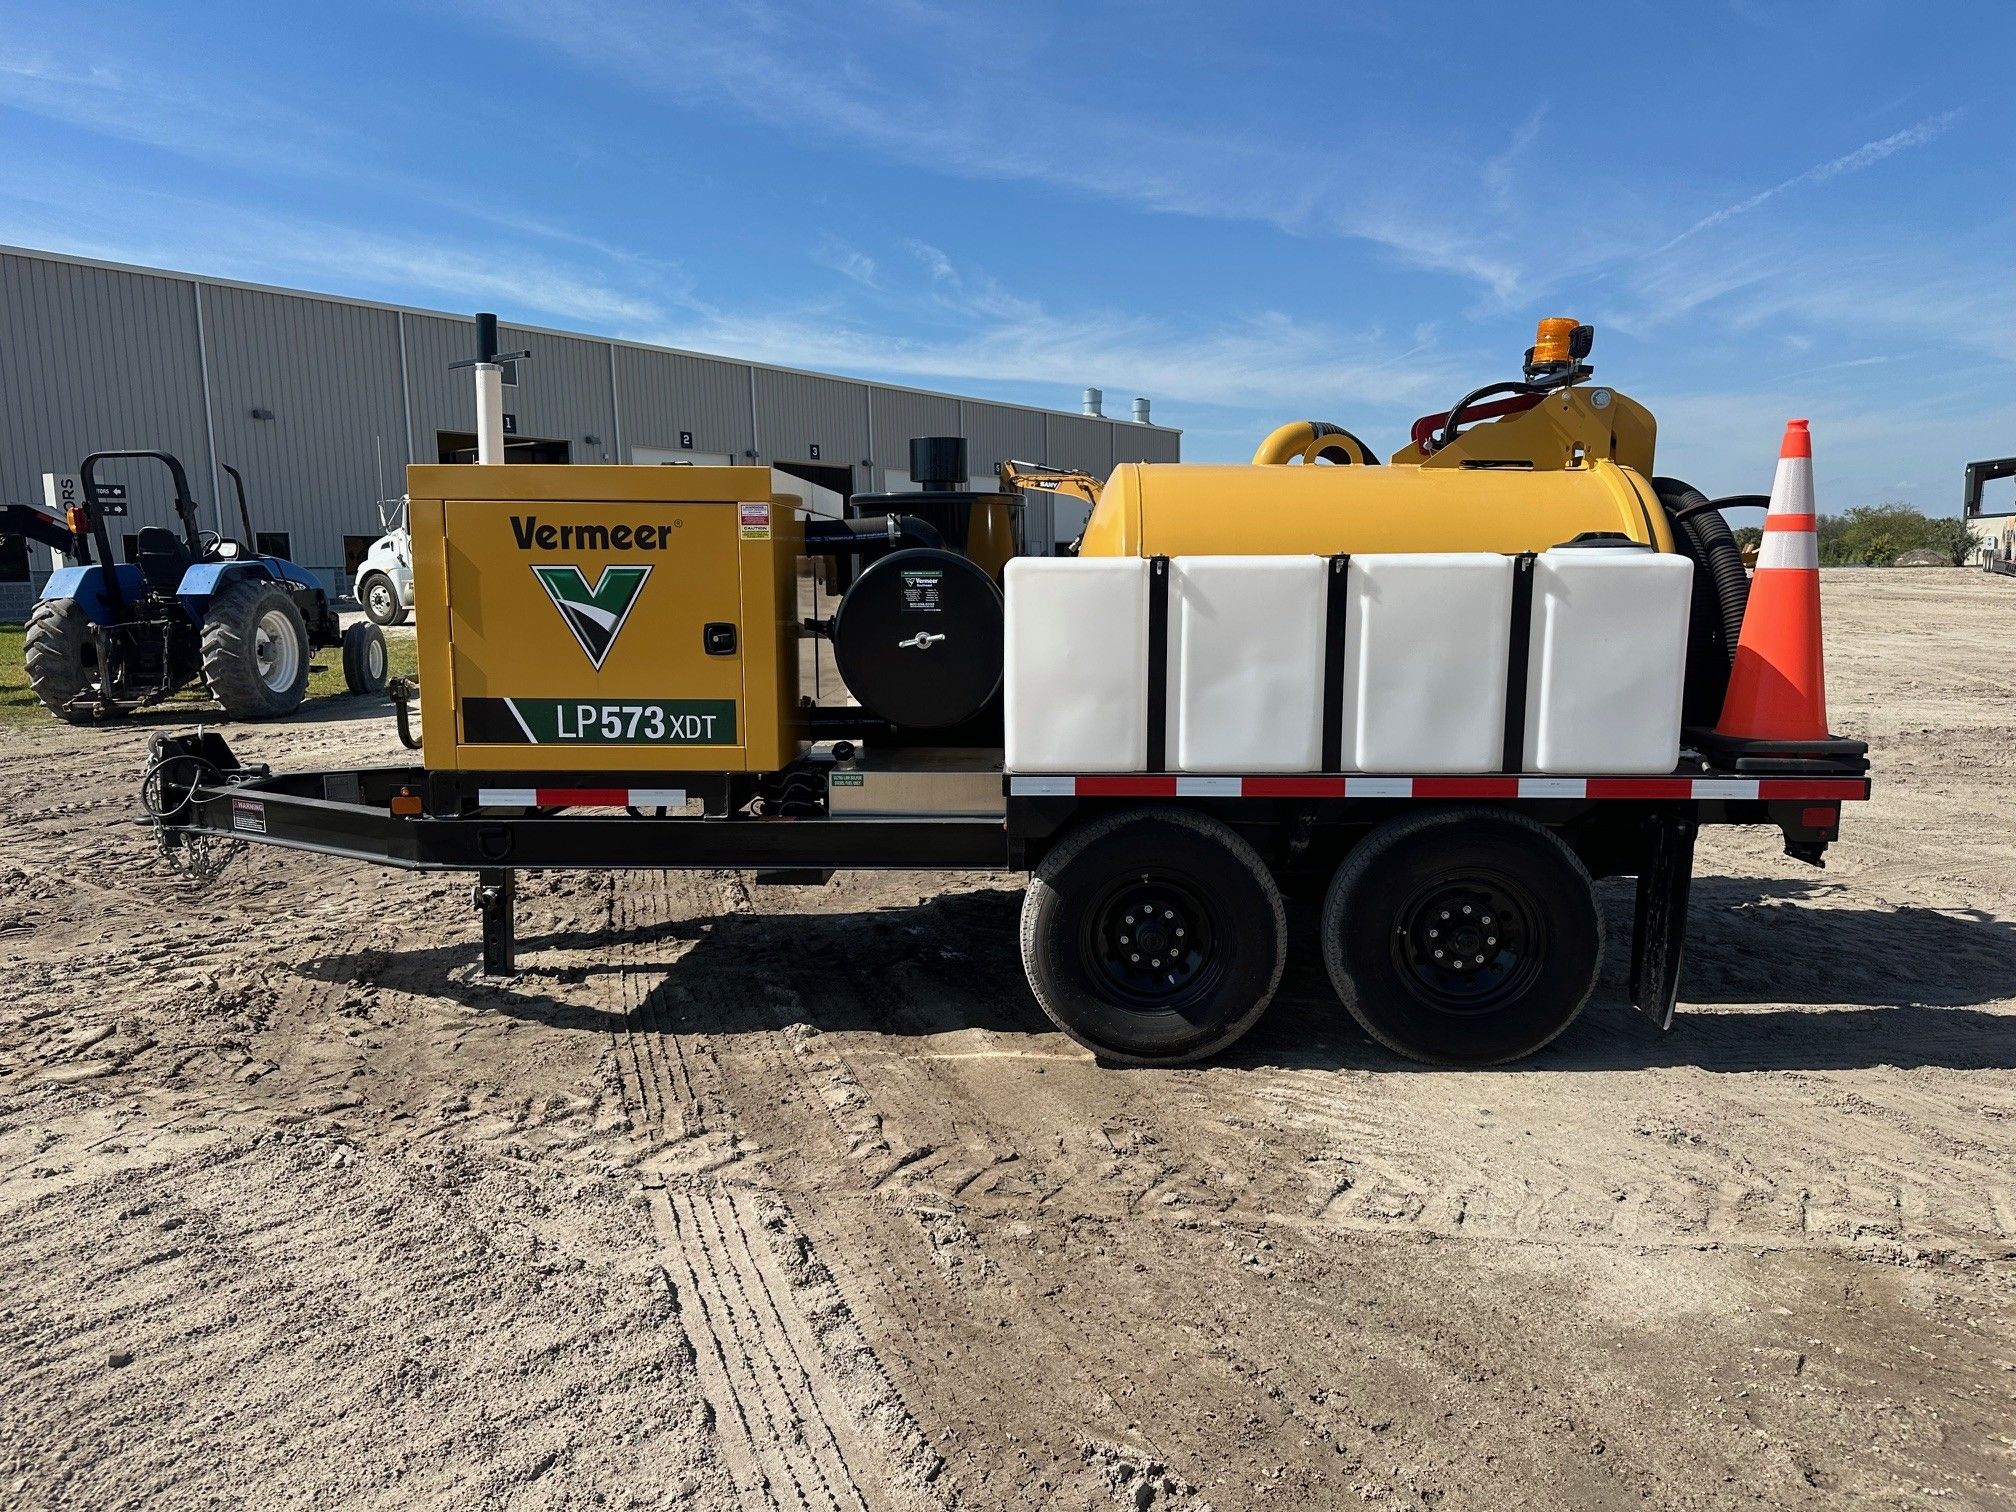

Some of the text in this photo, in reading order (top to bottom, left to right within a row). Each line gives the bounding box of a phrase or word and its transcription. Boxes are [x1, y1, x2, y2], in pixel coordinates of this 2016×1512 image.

[506, 418, 511, 428] 1
[684, 434, 690, 444] 2
[812, 447, 818, 456] 3
[61, 479, 75, 512] ORS
[510, 516, 672, 550] Vermeer
[238, 802, 264, 812] WARNING
